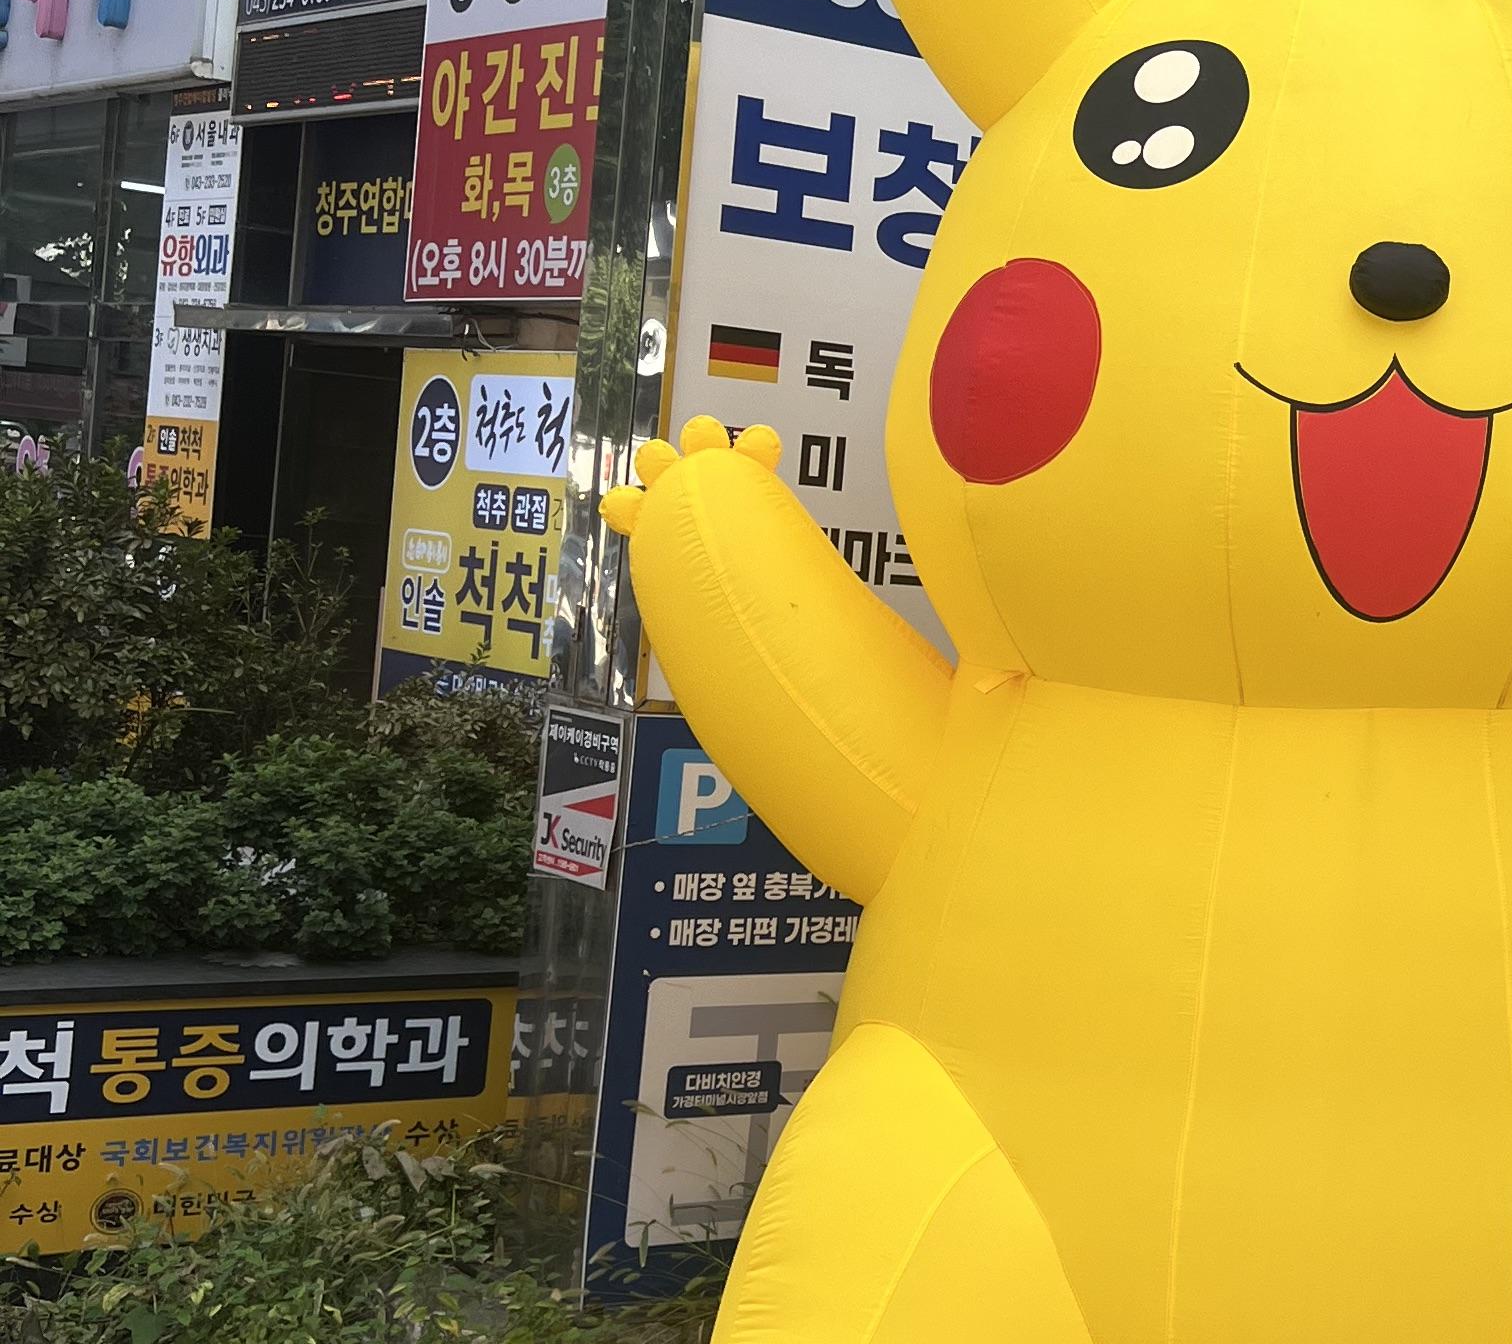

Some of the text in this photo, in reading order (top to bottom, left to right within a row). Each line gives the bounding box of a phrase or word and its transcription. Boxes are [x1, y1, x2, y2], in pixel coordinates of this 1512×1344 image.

[432, 36, 604, 140] 야간진
[196, 120, 240, 148] 서울내과
[461, 151, 534, 223] 화,목
[549, 163, 579, 206] 3층
[161, 234, 229, 277] 유항외과
[412, 238, 462, 292] (오후
[469, 237, 507, 288] 8시
[182, 327, 222, 357] 생생치과
[805, 340, 855, 401] 독
[159, 428, 177, 453] 인솔
[180, 424, 203, 461] 척척
[415, 402, 457, 464] 2층
[799, 433, 847, 492] 미
[476, 490, 507, 526] 척추
[514, 492, 548, 530] 관절
[401, 574, 446, 634] 인솔
[455, 540, 549, 661] 척척
[677, 762, 732, 836] P
[541, 812, 562, 849] JK
[561, 827, 607, 867] Security
[673, 873, 725, 903] 매장
[732, 872, 757, 900] 옆
[669, 918, 720, 948] 매장
[727, 917, 776, 946] 뒤편
[90, 1014, 469, 1103] 통증의학과
[685, 1070, 762, 1091] 다비치안경
